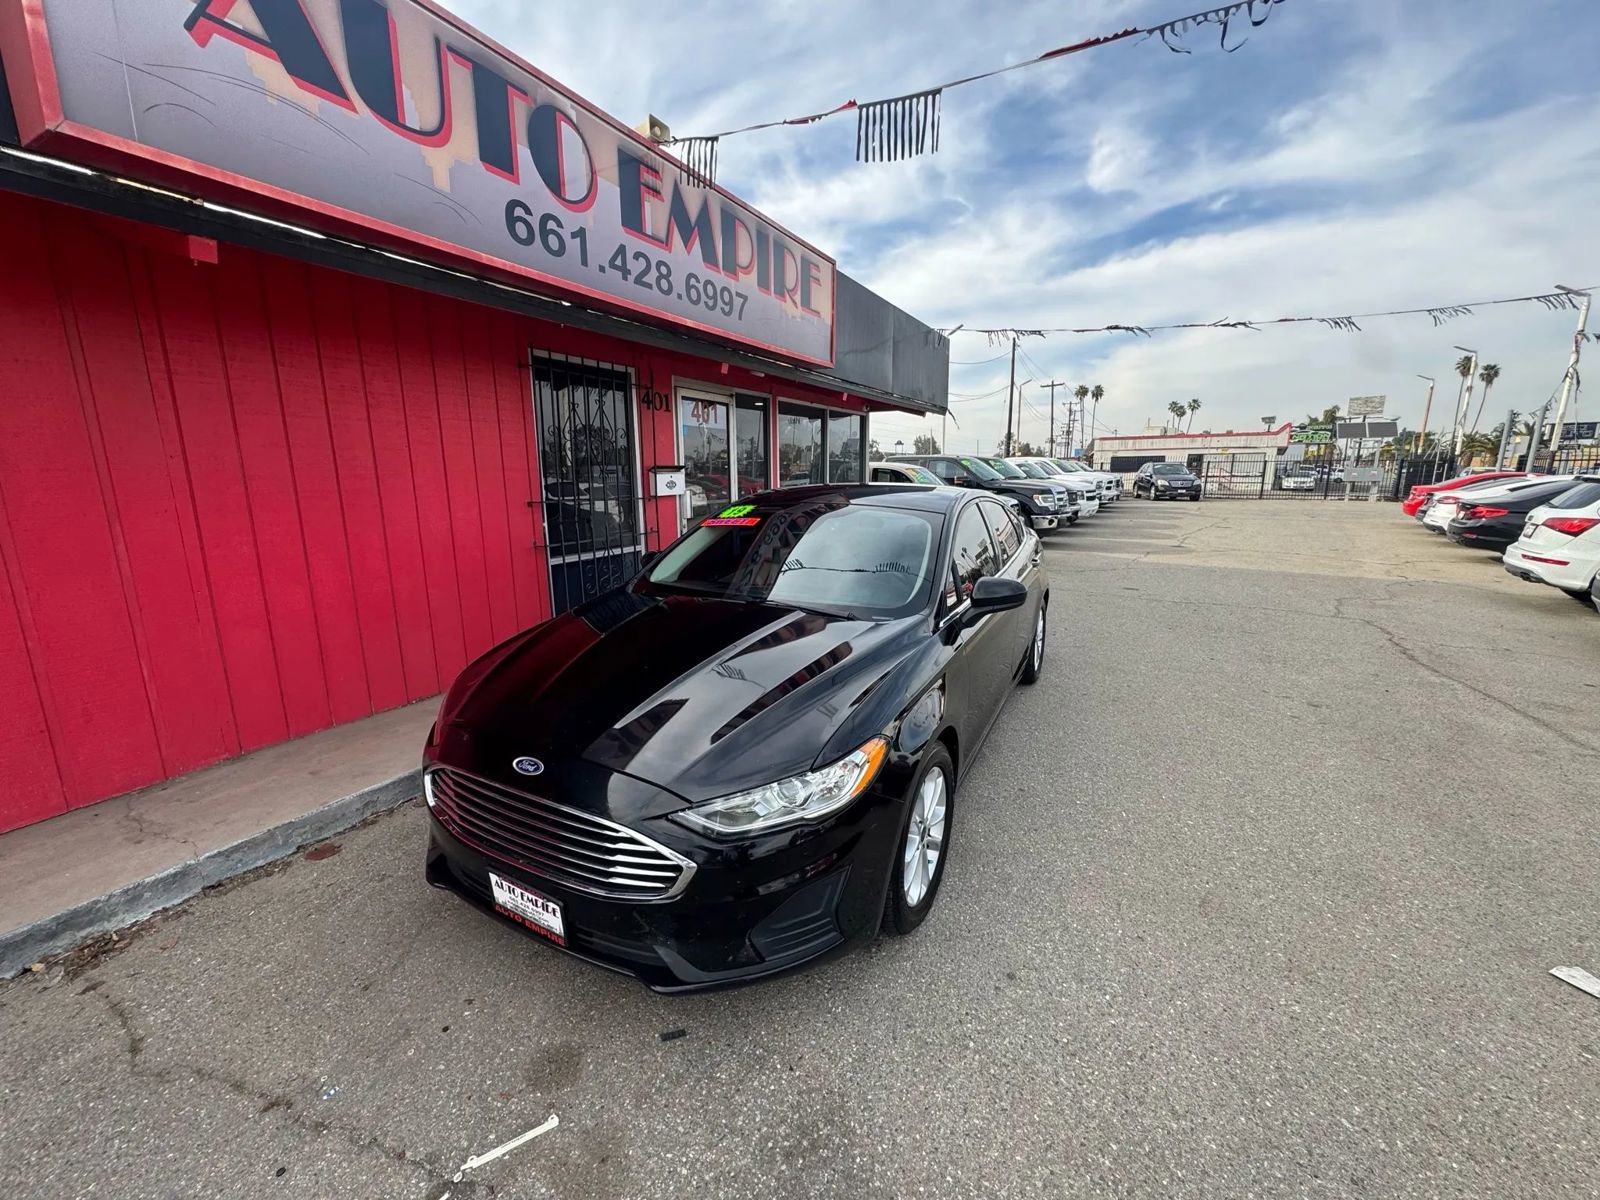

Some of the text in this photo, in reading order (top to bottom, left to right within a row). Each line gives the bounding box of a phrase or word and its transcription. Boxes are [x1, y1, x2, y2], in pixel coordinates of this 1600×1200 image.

[617, 144, 822, 318] EMPIRE
[504, 198, 749, 321] 661.428.6997
[641, 389, 672, 412] 401
[691, 400, 719, 424] 401
[518, 759, 538, 772] Ford
[494, 879, 520, 898] AUTO
[495, 904, 523, 922] AUTO
